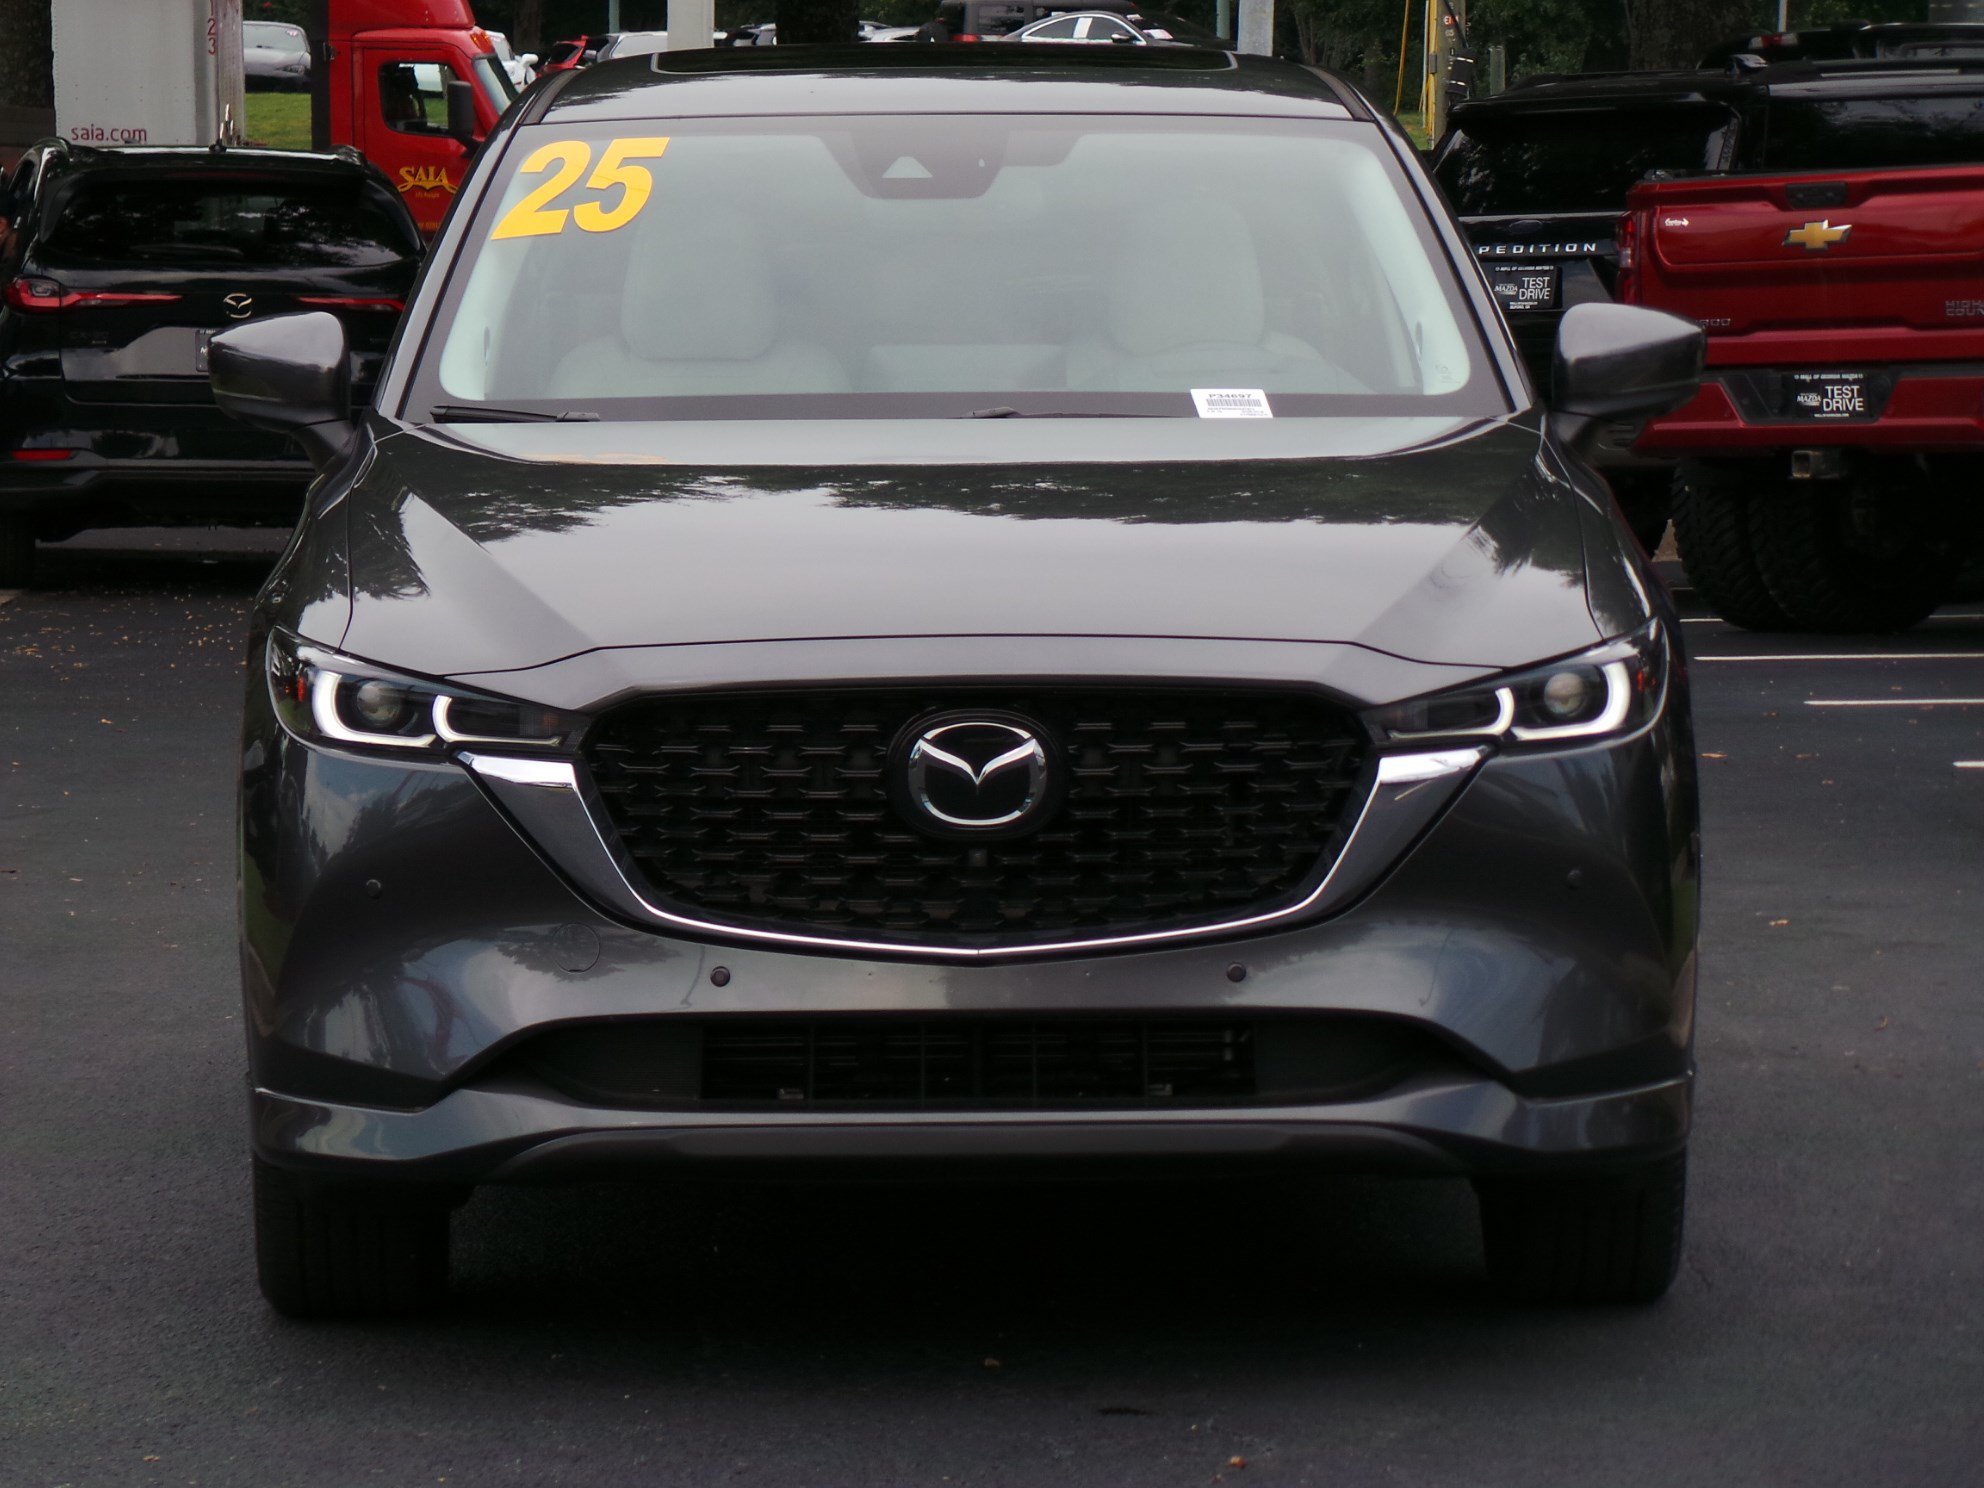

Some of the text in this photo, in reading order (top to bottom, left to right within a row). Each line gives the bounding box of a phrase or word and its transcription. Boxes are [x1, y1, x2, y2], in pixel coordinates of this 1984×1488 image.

[71, 124, 148, 142] saia.com
[397, 166, 457, 193] SAIA
[490, 136, 670, 241] 25
[1522, 277, 1551, 289] TEST
[1519, 288, 1551, 300] DRIVE
[1825, 385, 1860, 398] TEST
[1822, 398, 1864, 411] DRIVE
